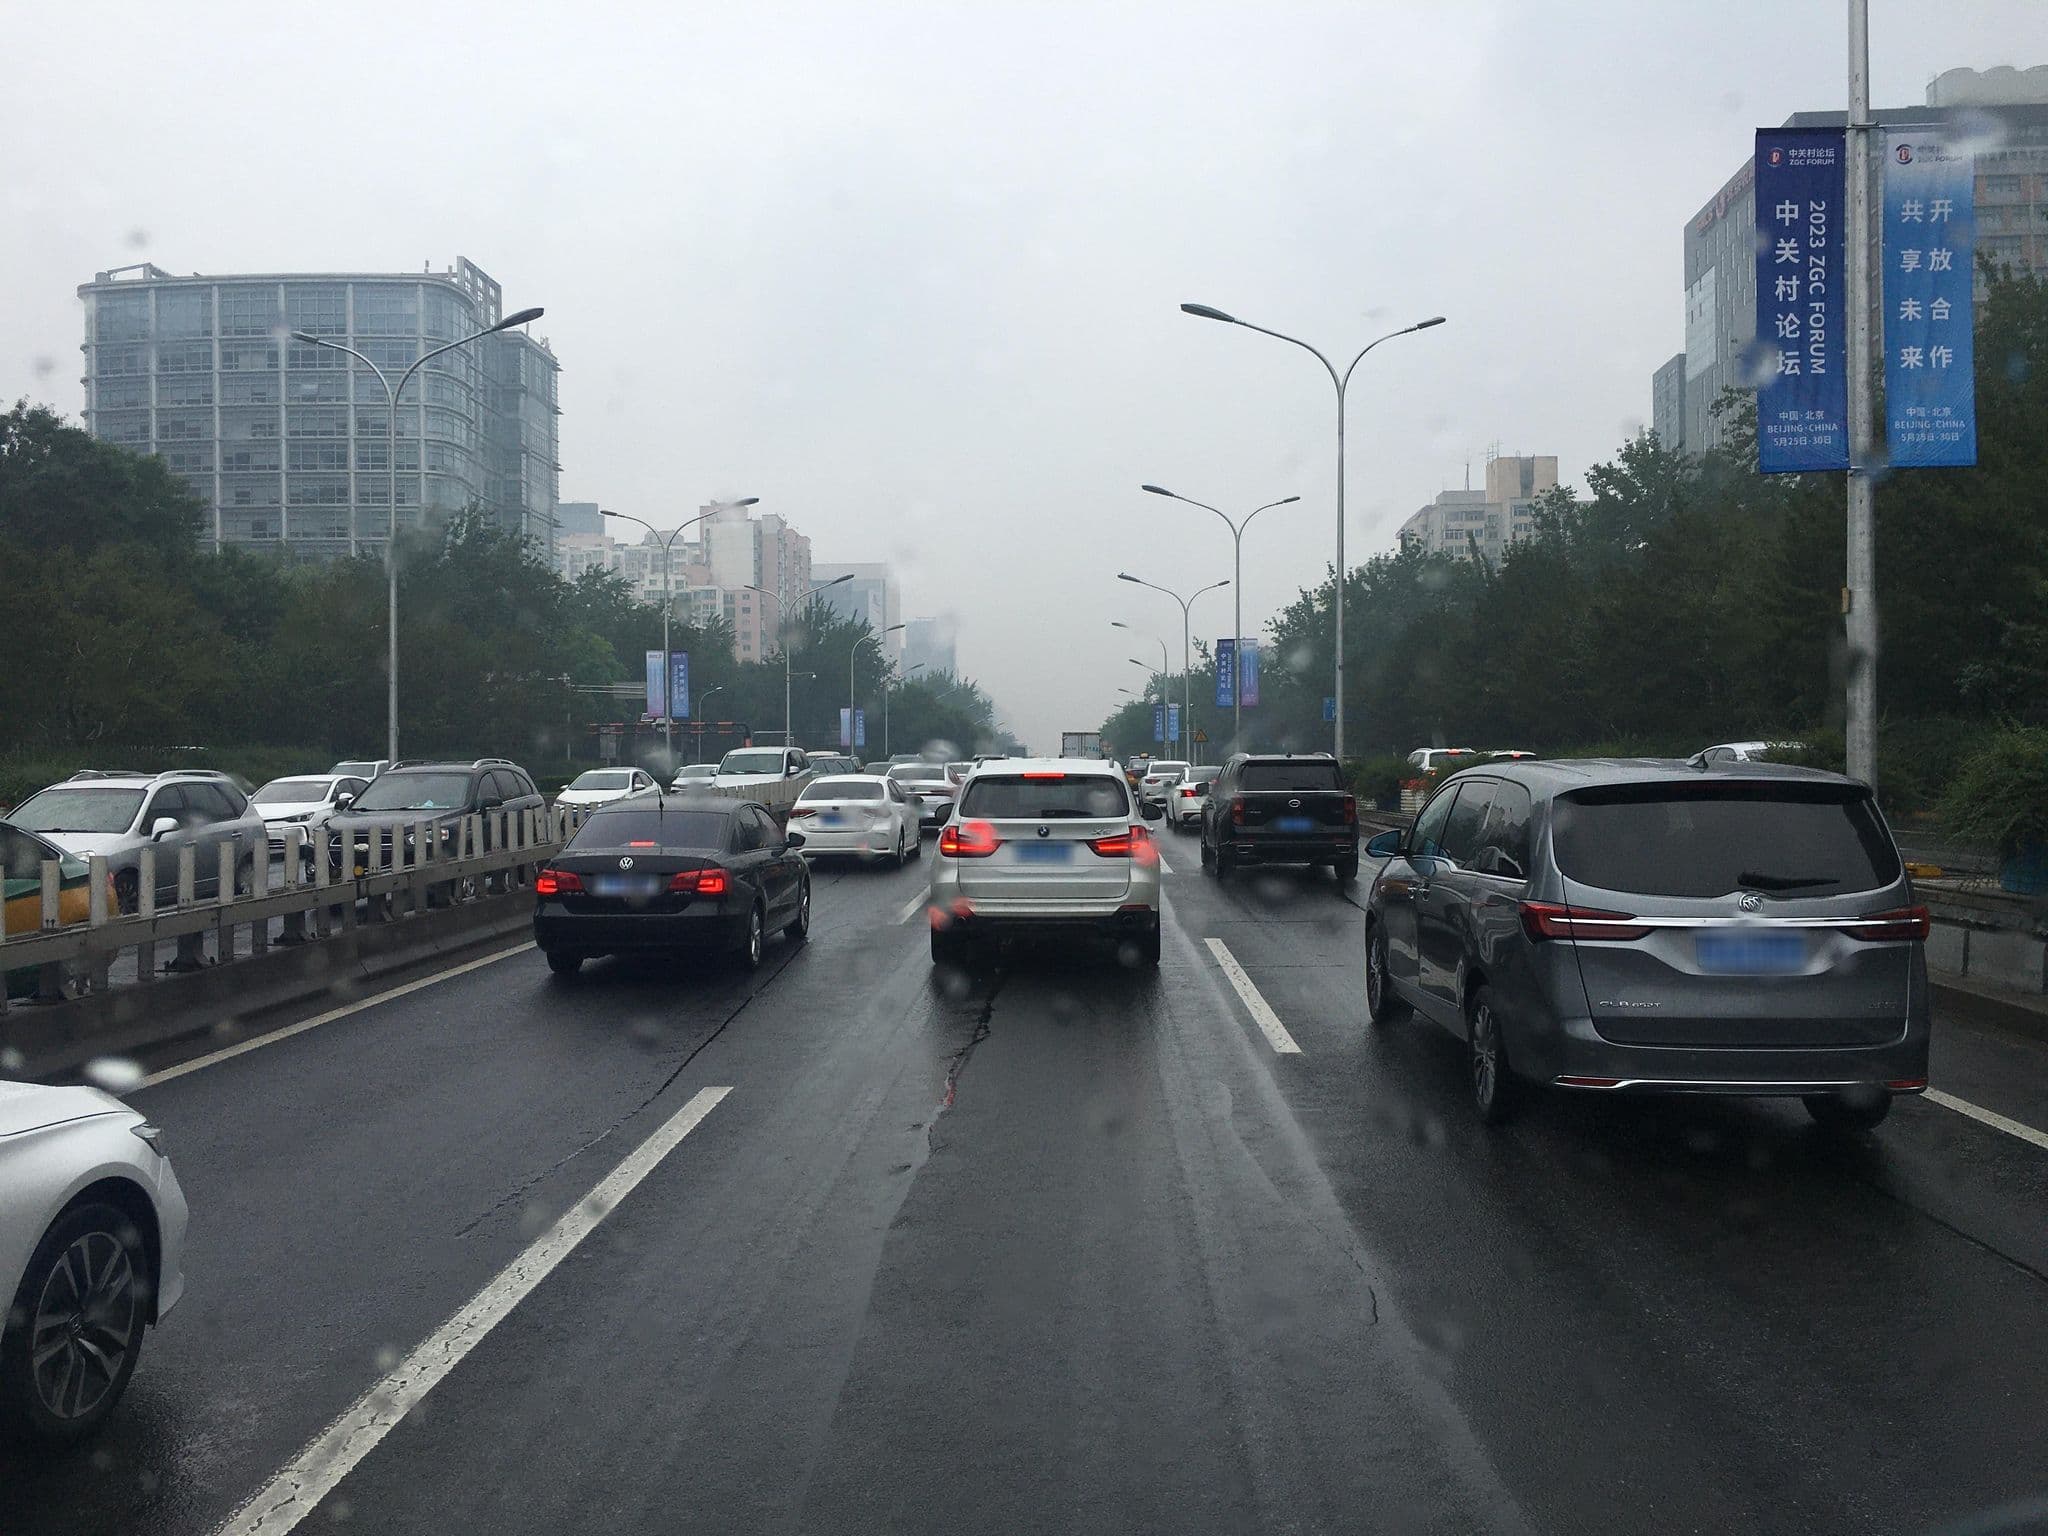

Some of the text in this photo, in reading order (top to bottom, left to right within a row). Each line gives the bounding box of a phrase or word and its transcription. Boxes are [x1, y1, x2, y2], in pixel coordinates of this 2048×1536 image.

[1788, 147, 1835, 158] 中关村论坛
[1806, 158, 1835, 166] FORUM
[1774, 199, 1801, 376] 中关村论坛
[1808, 200, 1826, 375] 2023 ZGC FORUM
[1899, 199, 1924, 370] 共享未来
[1928, 199, 1953, 369] 开放合作
